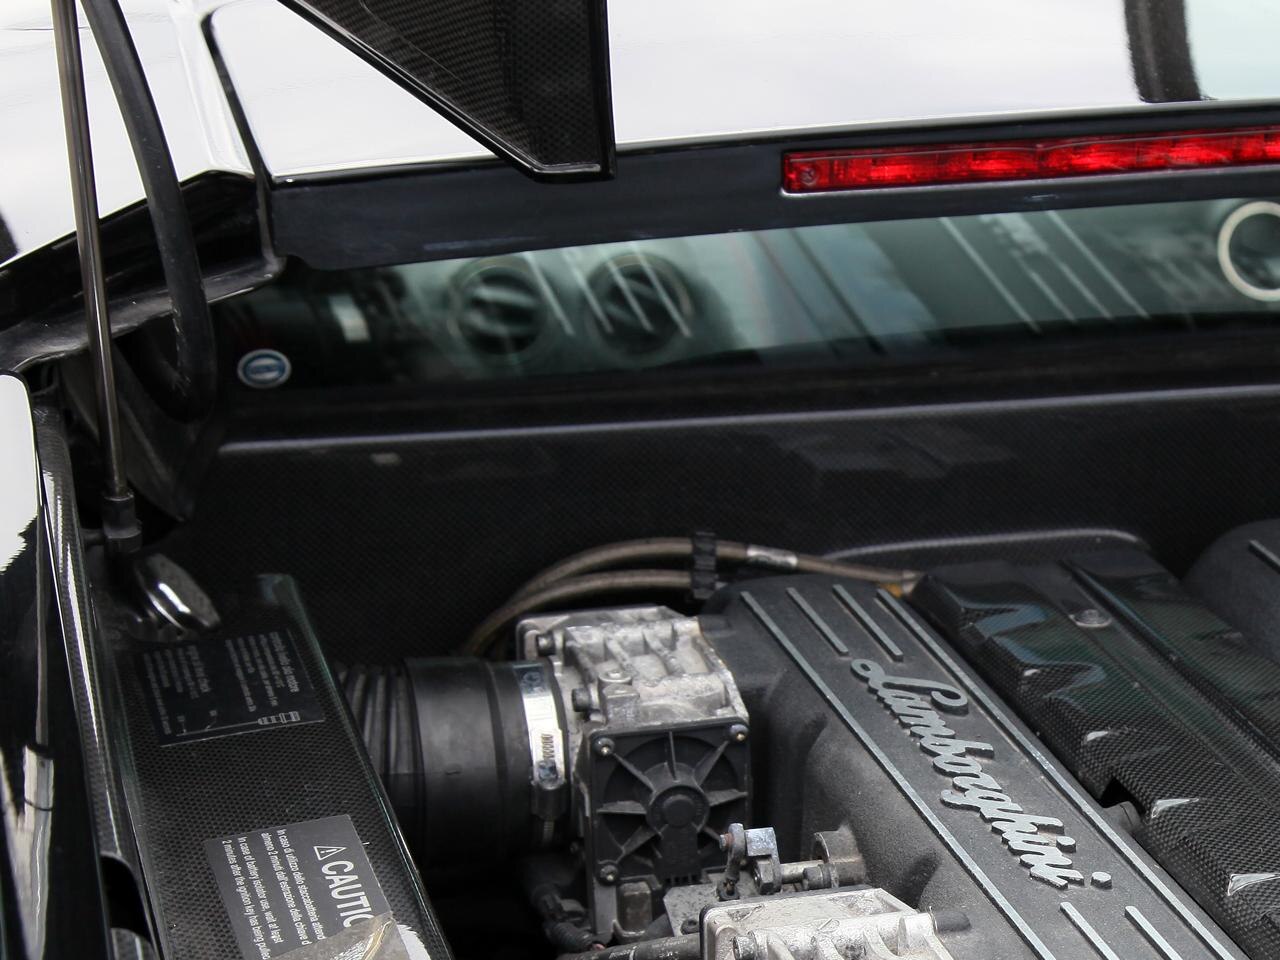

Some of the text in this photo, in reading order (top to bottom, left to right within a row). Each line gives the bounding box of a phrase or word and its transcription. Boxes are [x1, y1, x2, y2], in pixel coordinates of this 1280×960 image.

[286, 674, 299, 692] motore
[851, 657, 1113, 889] Lamborghini
[239, 842, 250, 855] case
[261, 832, 274, 851] almeno
[278, 835, 290, 847] caso
[223, 844, 236, 864] minutes
[285, 853, 298, 871] utilizzo
[230, 864, 241, 876] after
[246, 860, 259, 879] battery
[269, 855, 284, 871] minuti
[234, 876, 245, 885] the
[292, 871, 305, 884] dello
[236, 885, 251, 905] ignition
[252, 878, 266, 898] isolator
[275, 871, 295, 908] dall'estrazione
[321, 860, 375, 927] CAUTIO
[243, 904, 255, 915] key
[259, 898, 270, 911] use,
[297, 884, 319, 921] staccabatteria
[248, 914, 258, 926] has
[264, 910, 276, 923] wait
[289, 908, 302, 922] della
[252, 925, 264, 942] being
[270, 928, 283, 943] least
[294, 921, 307, 939] chiave
